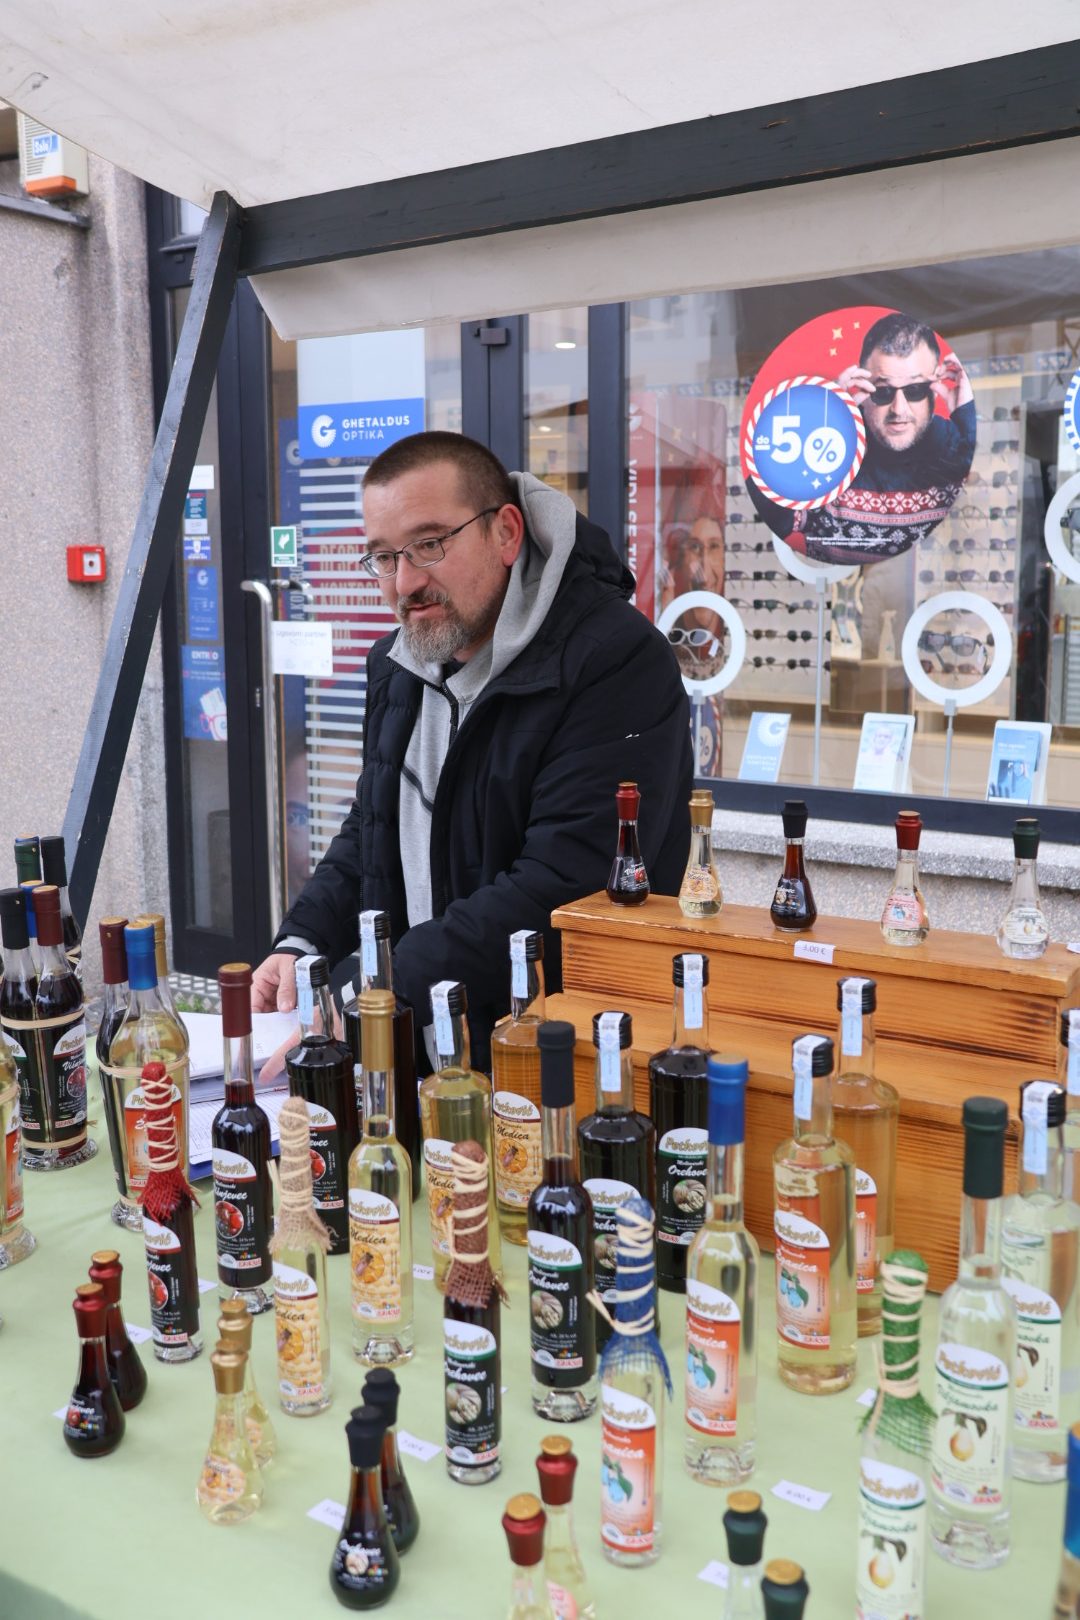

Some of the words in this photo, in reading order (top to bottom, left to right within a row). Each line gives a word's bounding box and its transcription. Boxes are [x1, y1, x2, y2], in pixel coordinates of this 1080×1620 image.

[341, 415, 410, 429] GHETALDUS
[342, 430, 385, 442] OPTIKA
[496, 1123, 530, 1140] Medica
[428, 1173, 456, 1190] Medic
